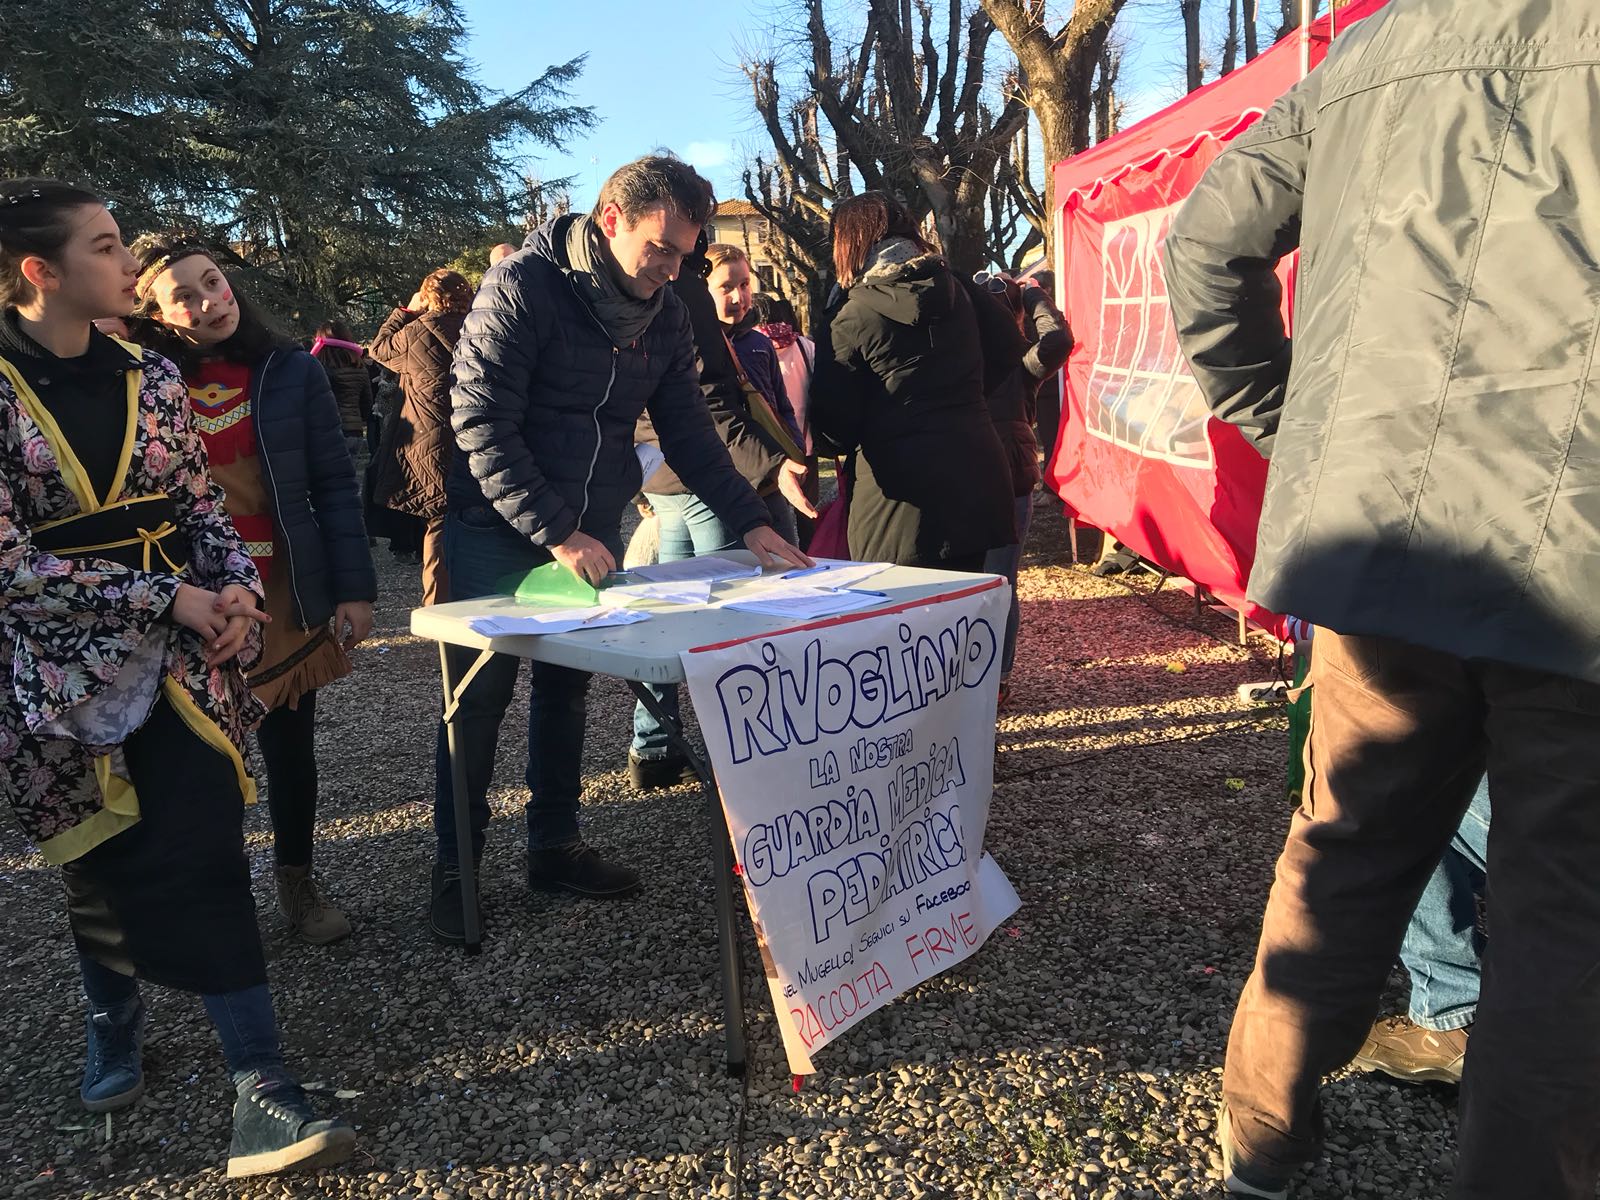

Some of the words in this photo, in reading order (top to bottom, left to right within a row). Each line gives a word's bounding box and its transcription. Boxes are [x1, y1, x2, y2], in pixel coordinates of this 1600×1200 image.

[715, 616, 997, 764] RIVOGLIAMO
[809, 750, 841, 789] LA
[849, 728, 914, 775] NOSTRA
[743, 785, 881, 887] GUARDIA
[888, 736, 966, 832] MEDICA
[790, 961, 893, 1048] RACCOLTA
[905, 911, 978, 975] FIRME
